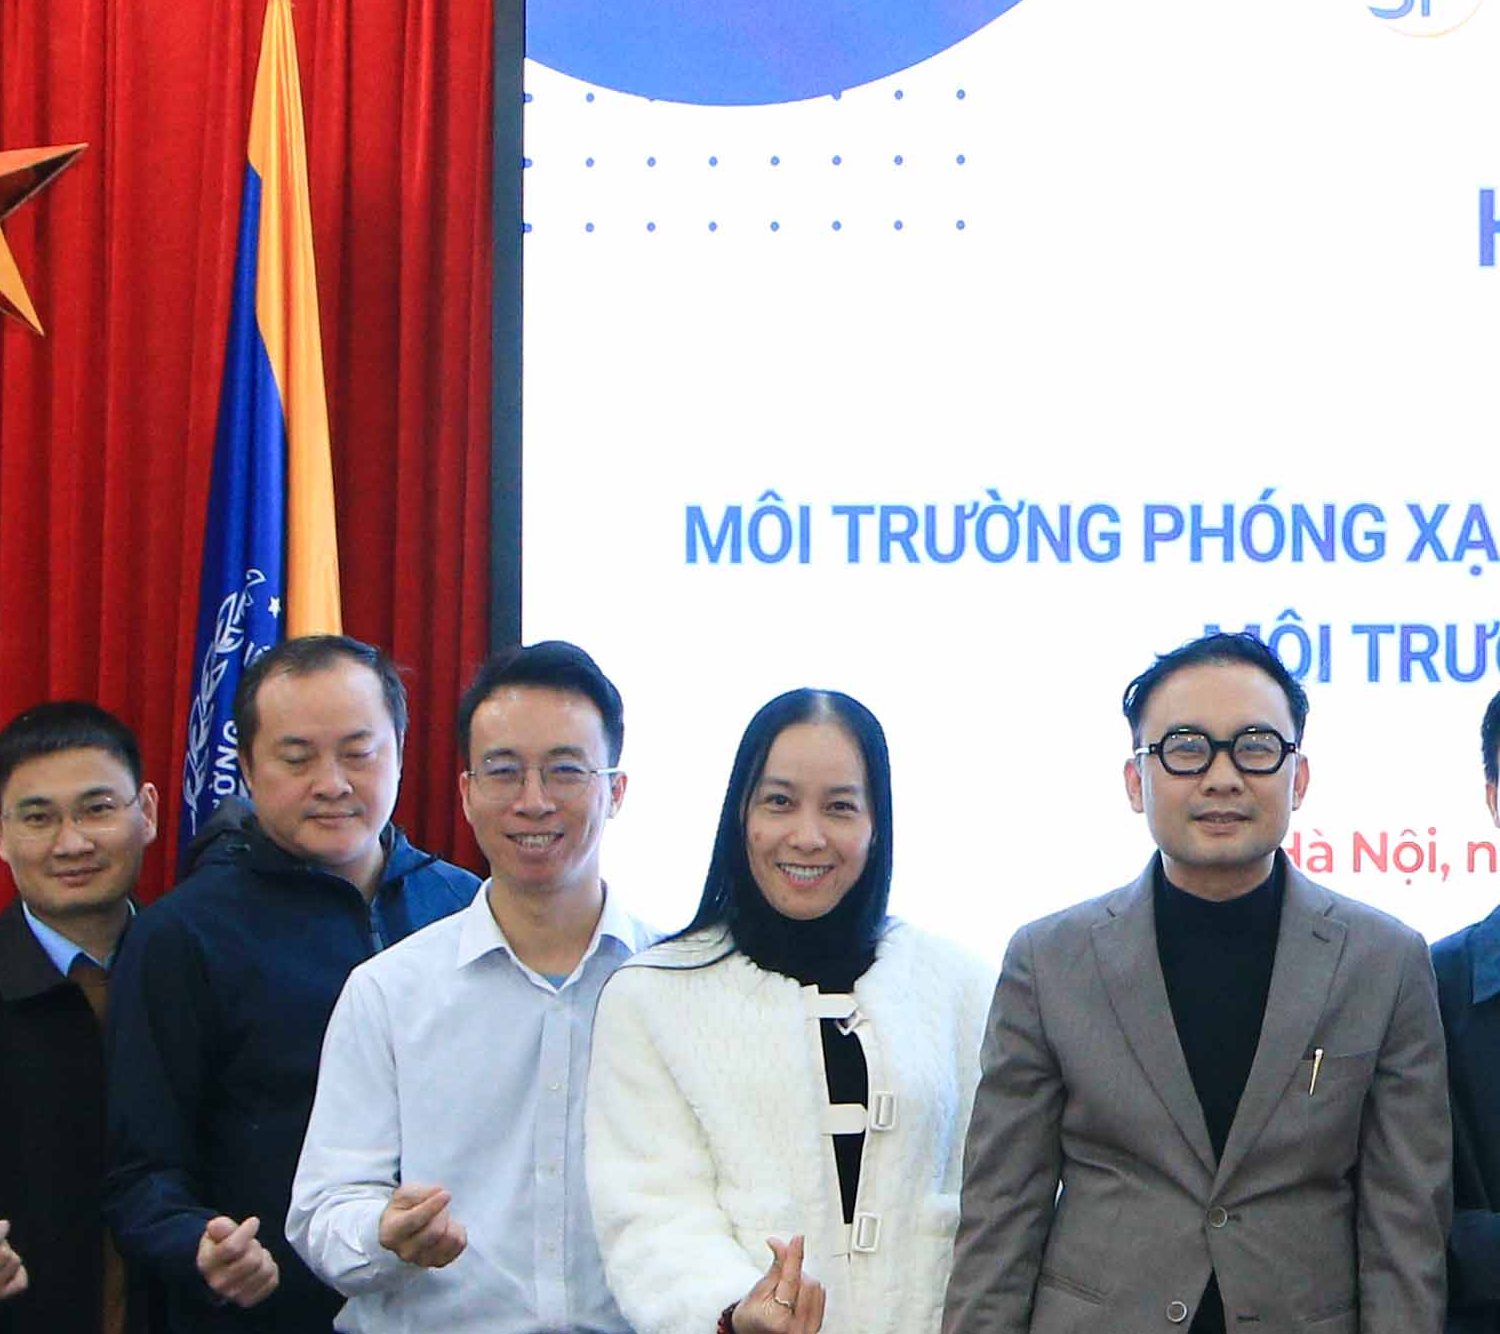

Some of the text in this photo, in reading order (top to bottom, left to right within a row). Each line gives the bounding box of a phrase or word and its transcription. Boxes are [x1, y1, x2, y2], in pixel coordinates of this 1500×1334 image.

[685, 489, 811, 565] MÔI
[830, 487, 1121, 564] TRƯỜNG
[1143, 487, 1386, 563] PHÓNG
[1203, 608, 1332, 683] ÔI
[1354, 827, 1450, 878] Nội,
